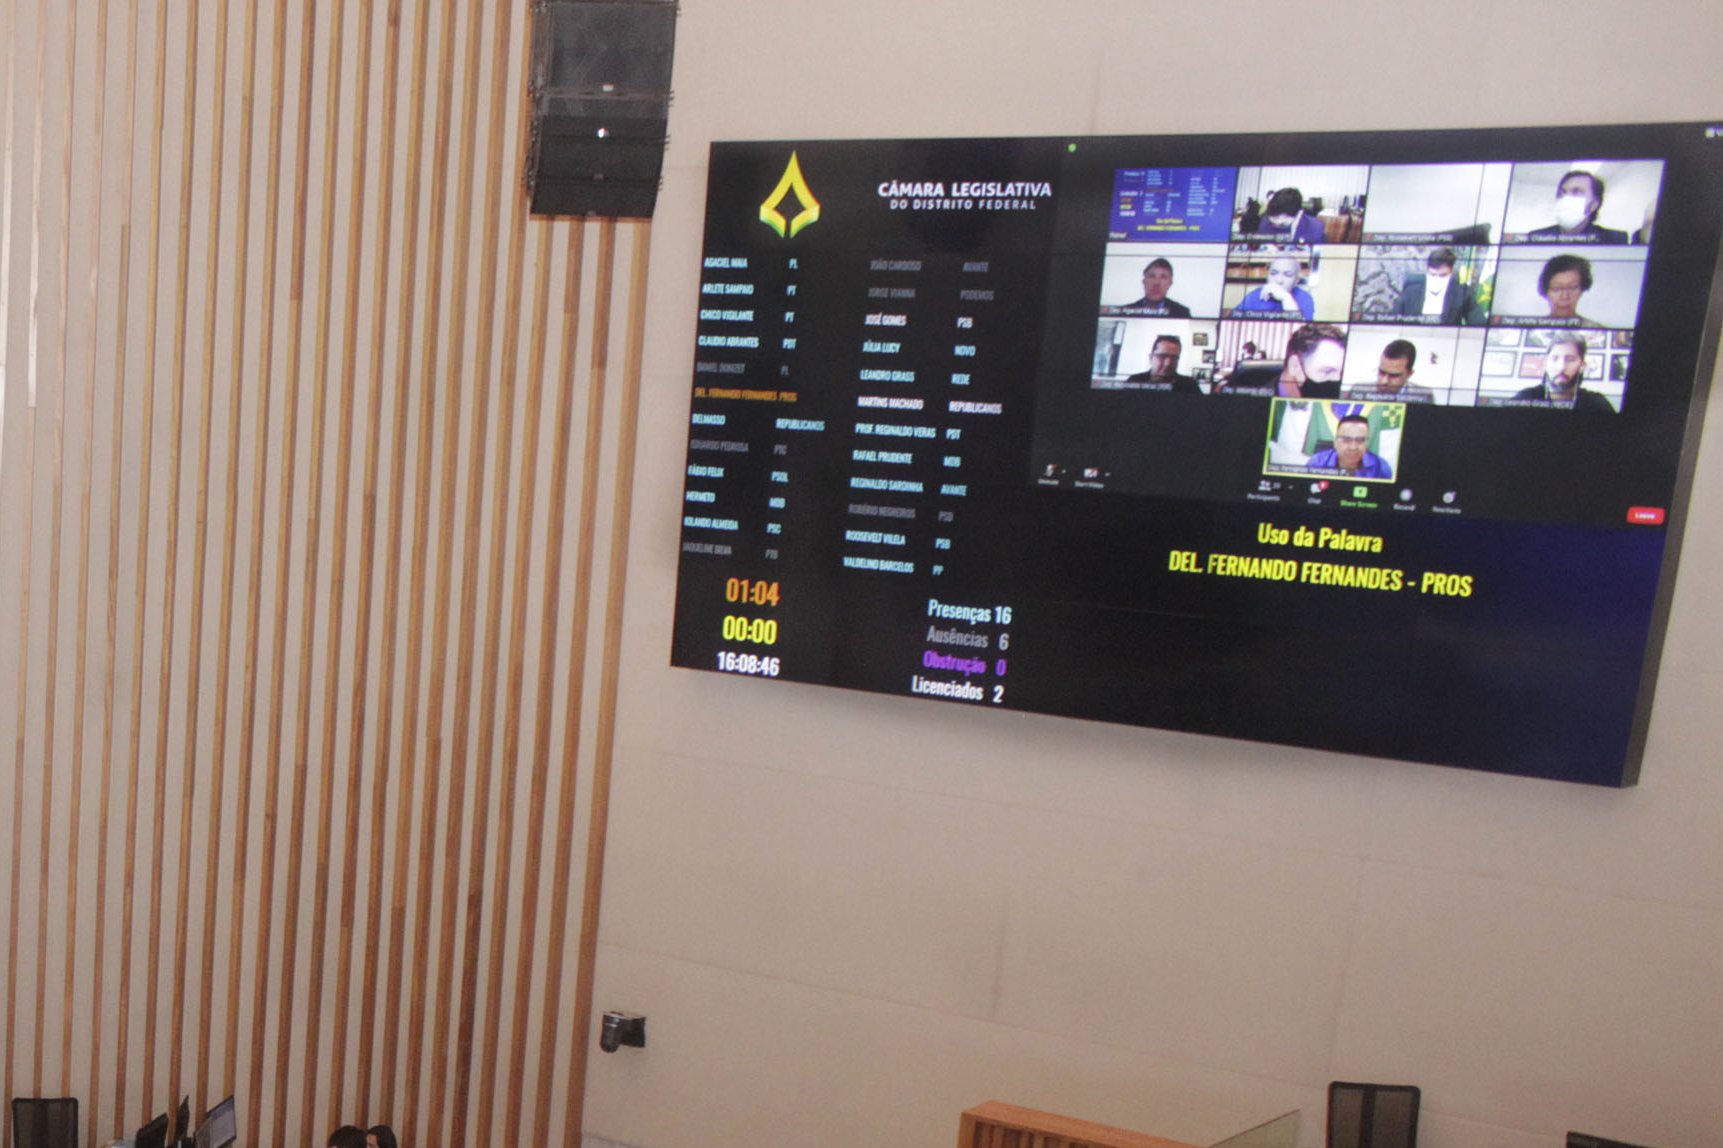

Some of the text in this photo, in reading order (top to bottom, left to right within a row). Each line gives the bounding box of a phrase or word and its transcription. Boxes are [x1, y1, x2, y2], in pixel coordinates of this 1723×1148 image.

[878, 180, 1051, 197] CÂMARA LEGISLATIVA
[890, 200, 1036, 210] DO DISTRITO FEDERAL
[1257, 522, 1383, 553] Uso da Palavra
[1169, 550, 1204, 574] DEL.
[1208, 553, 1297, 582] FERNANDO
[1300, 561, 1404, 591] FERNANDES
[1421, 572, 1474, 598] PROS
[726, 578, 779, 606] 01:04
[928, 599, 1012, 624] Presenças 16
[723, 616, 776, 644] 00:00
[927, 625, 1009, 650] Ausências 6
[718, 651, 780, 676] 16:08:46
[923, 651, 1006, 676] Obstrução 0
[912, 675, 1004, 702] Licenciados 2
